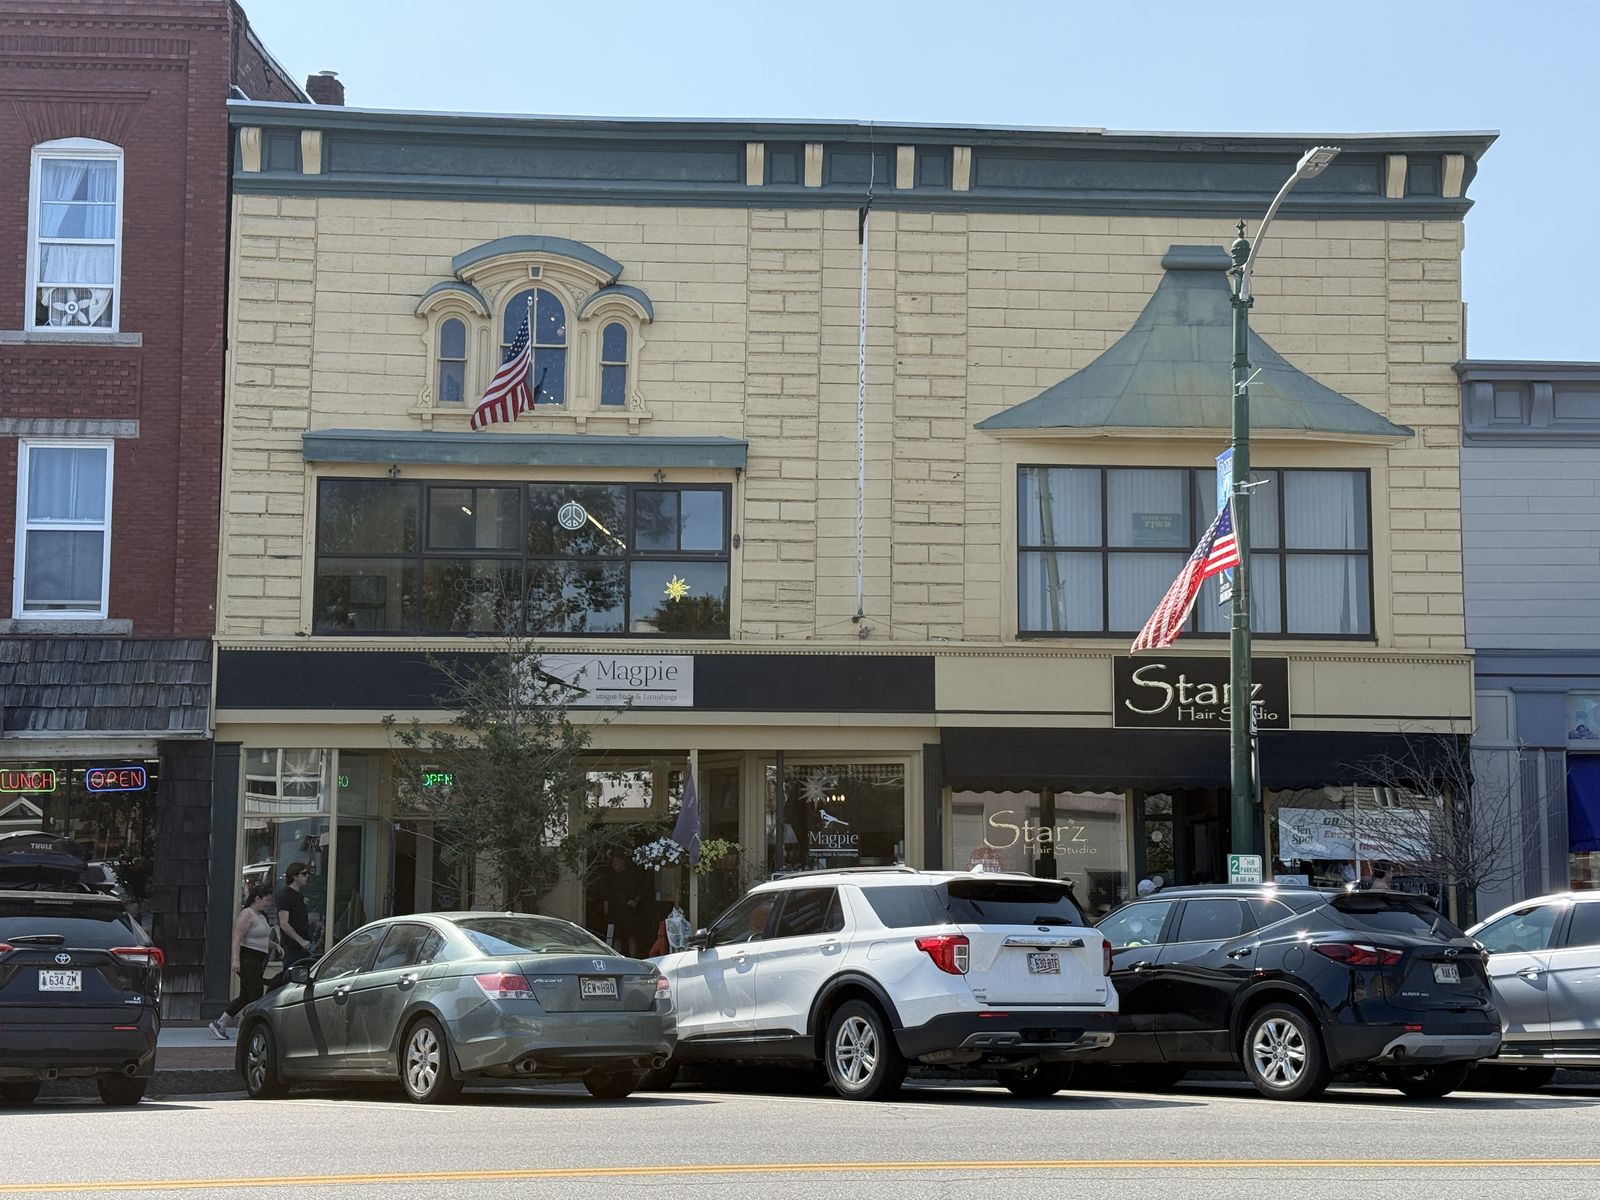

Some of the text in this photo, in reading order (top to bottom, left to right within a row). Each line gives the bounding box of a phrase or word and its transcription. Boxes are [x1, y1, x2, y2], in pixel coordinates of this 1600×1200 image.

[596, 660, 678, 687] Magpie
[1125, 664, 1266, 714] Starz
[1177, 706, 1216, 721] Hair
[1218, 706, 1278, 722] Sdio
[1, 771, 53, 789] LUNCH
[90, 771, 142, 789] OPEN
[984, 810, 1087, 848] Starz
[1292, 824, 1312, 835] Ten
[808, 830, 859, 848] Magpie
[1023, 843, 1097, 855] Hair Studio
[1231, 860, 1239, 872] 2
[49, 975, 77, 986] 634 ZM
